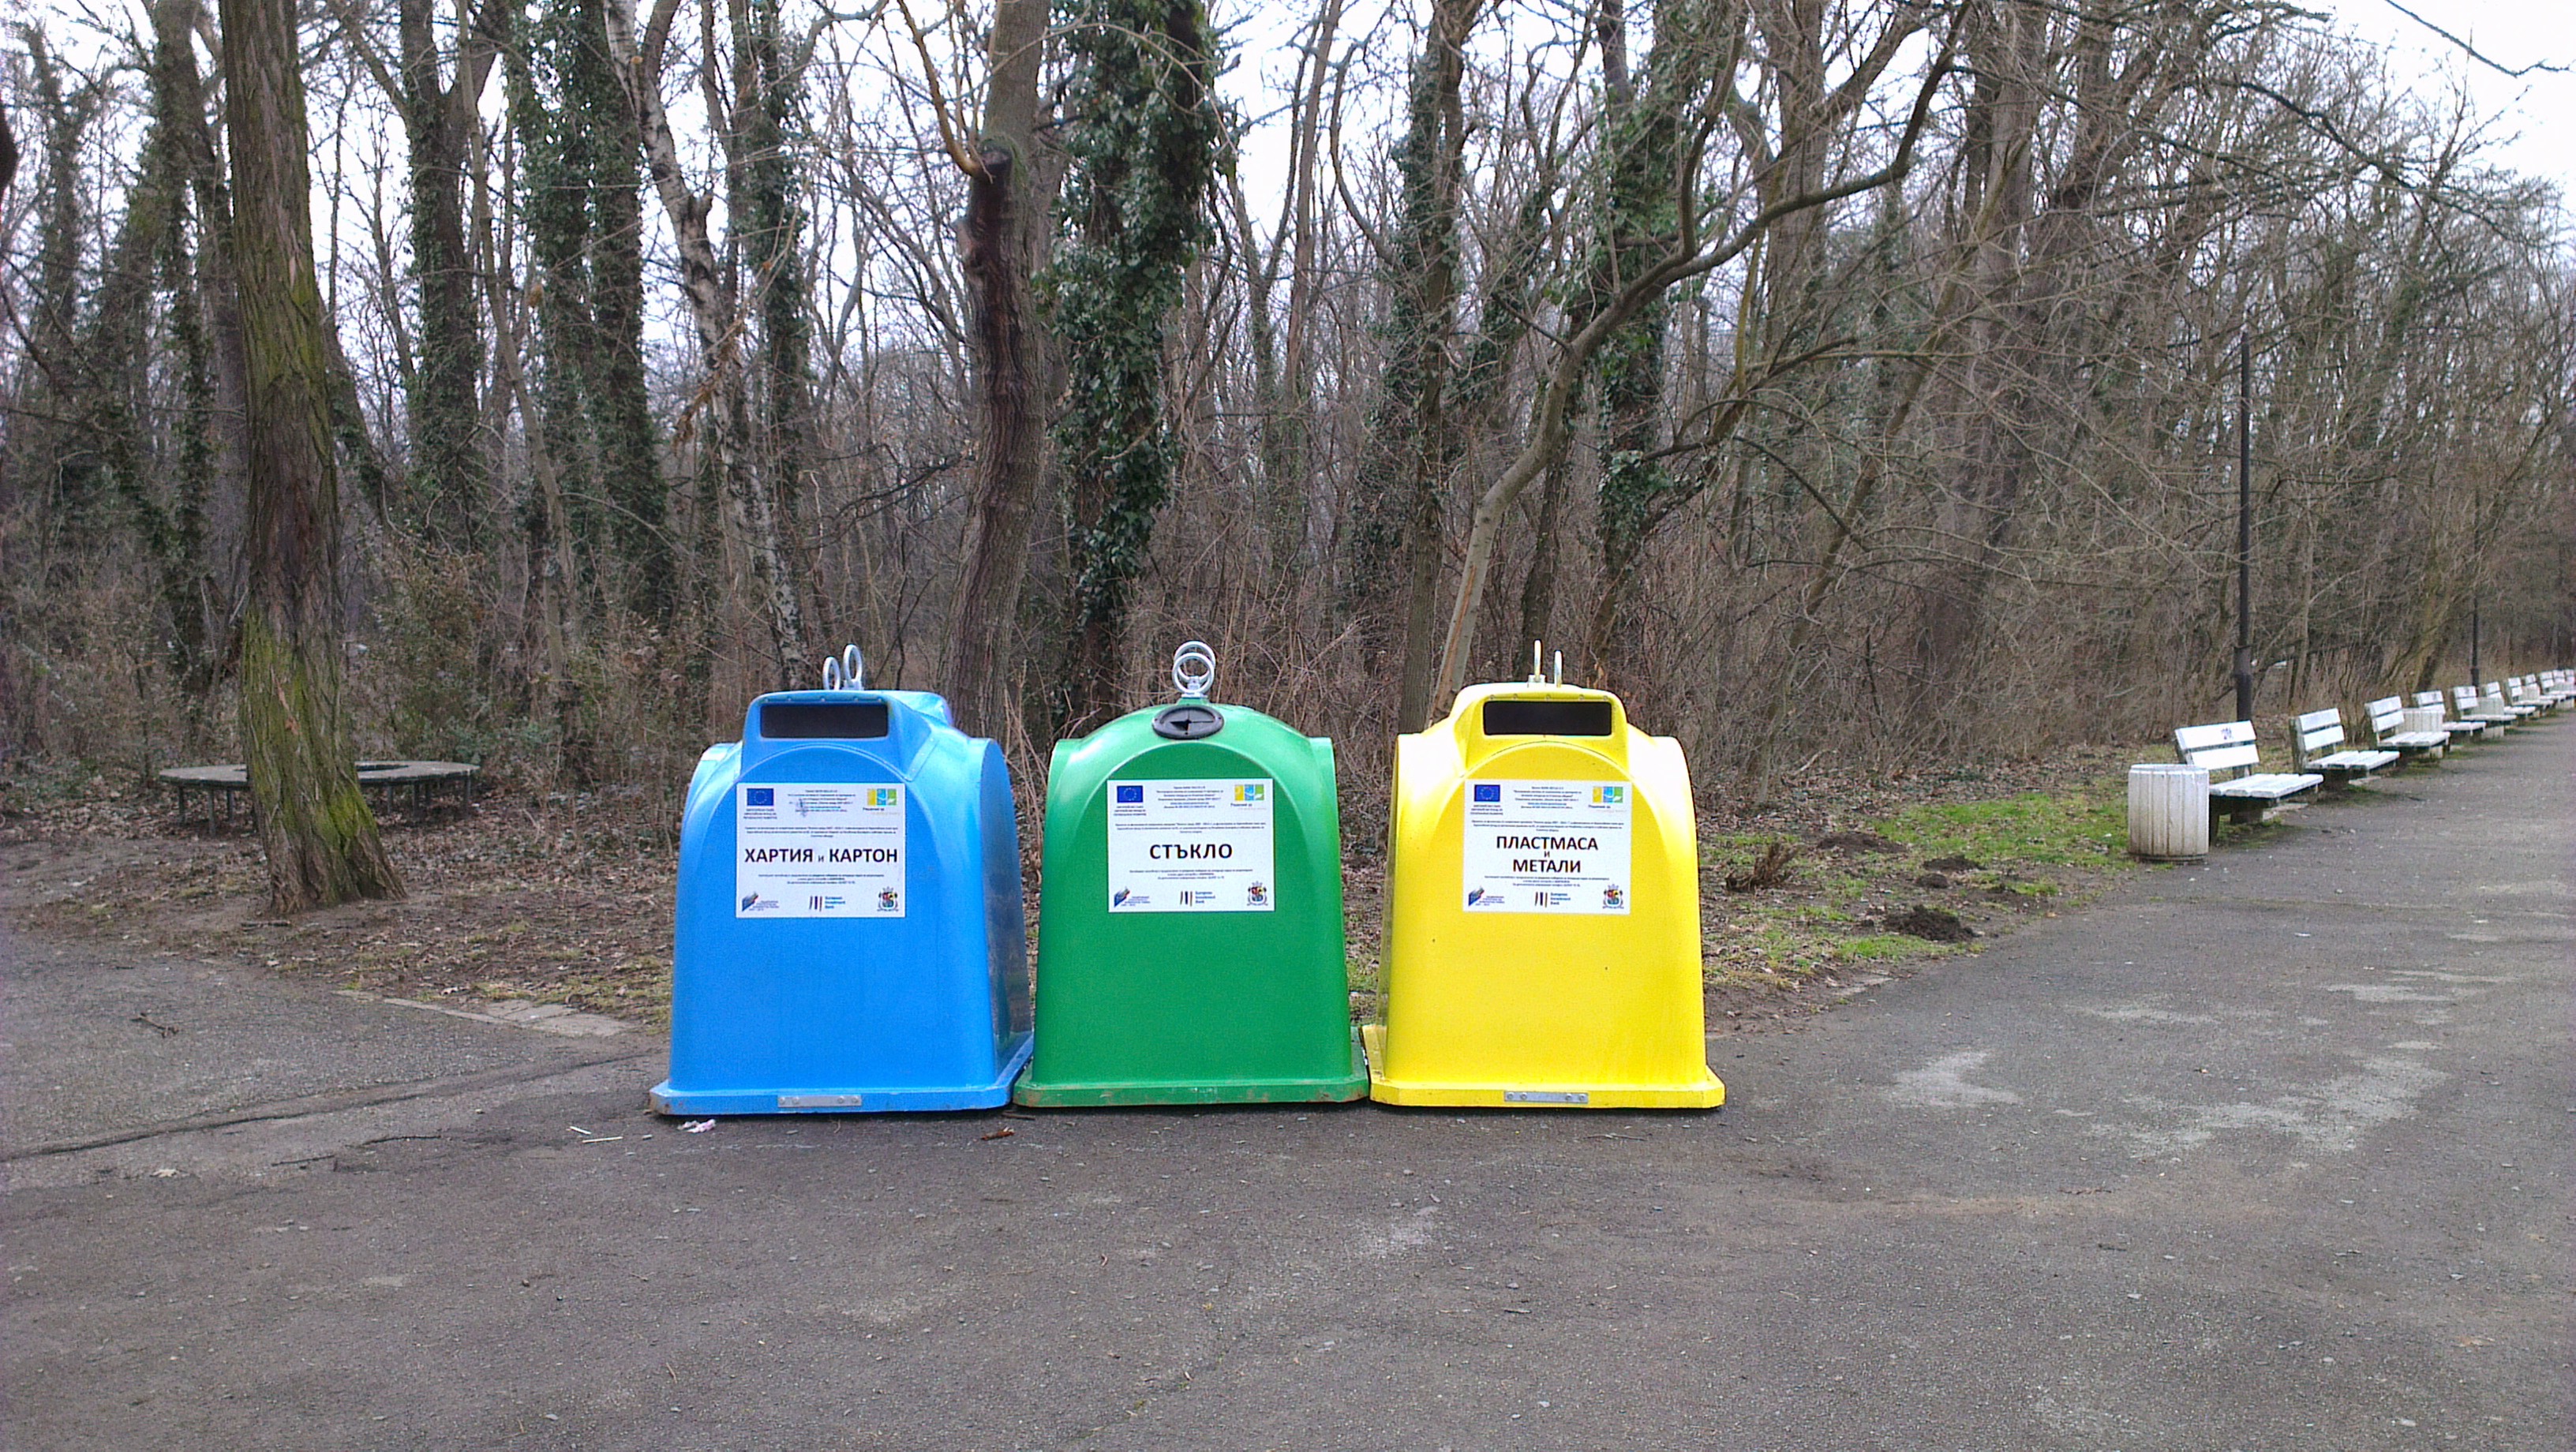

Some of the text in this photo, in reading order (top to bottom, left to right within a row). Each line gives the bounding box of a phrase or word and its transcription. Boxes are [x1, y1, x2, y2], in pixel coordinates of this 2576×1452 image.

[1496, 836, 1599, 851] ПЛАСТМАСА
[744, 848, 813, 863] ХАРТИЯ
[829, 848, 898, 863] КАРТОН
[1149, 844, 1233, 859] СТЪКЛО
[1513, 859, 1581, 873] МЕТАЛИ
